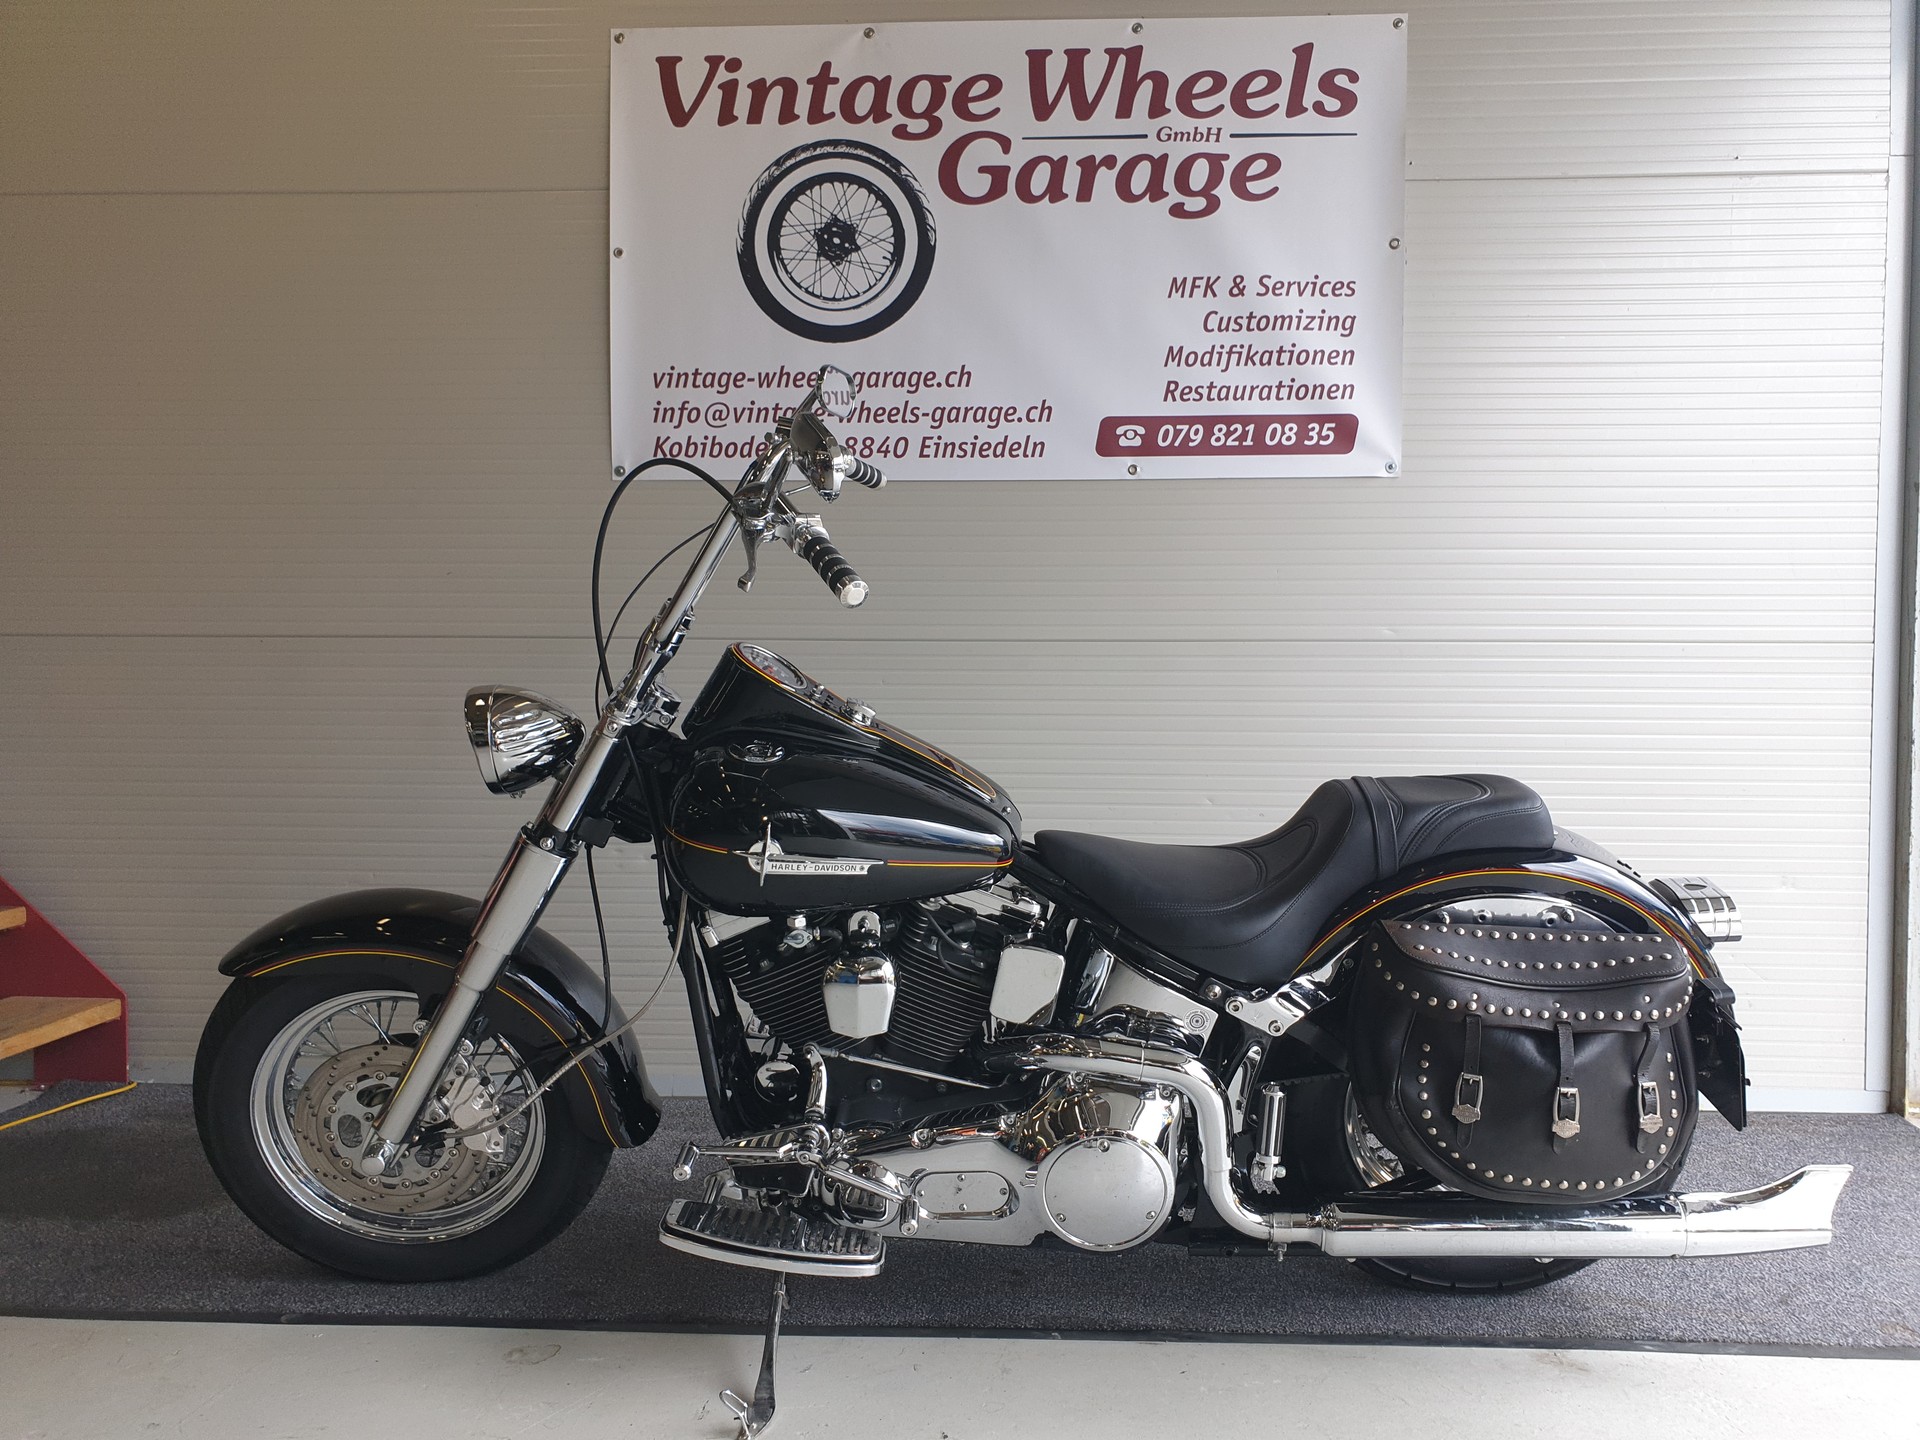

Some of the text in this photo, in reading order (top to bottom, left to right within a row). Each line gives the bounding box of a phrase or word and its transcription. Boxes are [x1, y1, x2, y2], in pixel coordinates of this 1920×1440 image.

[655, 42, 1360, 141] Vintage Wheels
[1155, 125, 1223, 143] GmbH
[937, 130, 1283, 219] Garage
[1167, 274, 1357, 298] MFK & Services
[1202, 308, 1357, 337] Customizing
[1163, 342, 1355, 372] Modifikationen
[653, 365, 972, 395] vintage-wheegarage.ch
[1162, 377, 1355, 402] Restaurationen
[652, 434, 1046, 459] Kobibode 8840 Einsiedeln
[1157, 422, 1336, 447] 079 821 08 35
[771, 863, 857, 872] HARLEY-DAVIDSON
